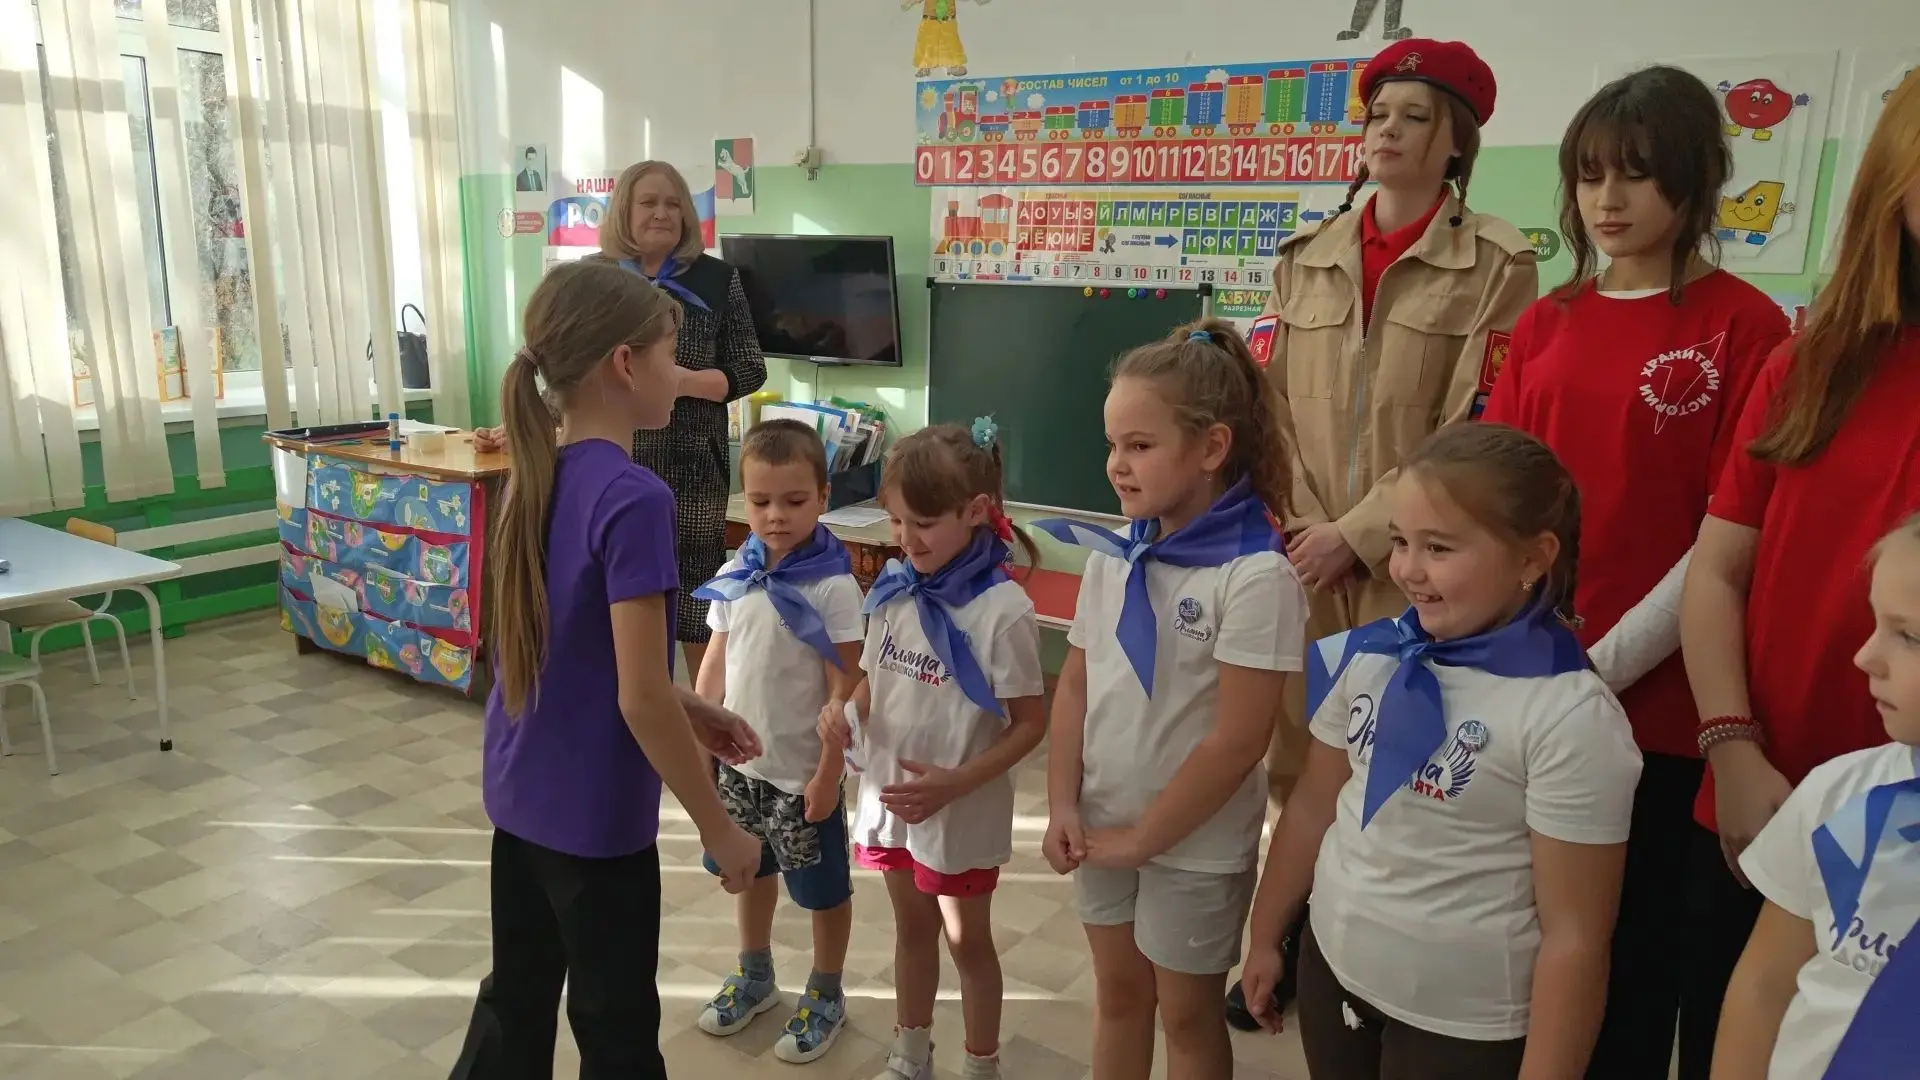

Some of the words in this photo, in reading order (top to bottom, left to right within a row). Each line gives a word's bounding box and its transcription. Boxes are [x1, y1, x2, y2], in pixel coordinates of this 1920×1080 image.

[1284, 70, 1290, 78] 9
[1324, 63, 1334, 71] 10
[1018, 80, 1064, 91] СОСТАВ
[1068, 77, 1108, 88] ЧИСЕЛ
[1120, 78, 1133, 86] от
[1136, 75, 1142, 84] 1
[1146, 76, 1161, 86] до
[1165, 73, 1179, 83] 10
[918, 151, 934, 179] 0
[941, 151, 951, 179] 1
[958, 151, 973, 179] 2
[978, 150, 994, 179] 3
[998, 149, 1016, 179] 4
[1020, 149, 1038, 178] 5
[1042, 148, 1060, 178] 6
[1065, 148, 1082, 178] 7
[1086, 147, 1106, 178] 8
[1110, 147, 1129, 178] 9
[1133, 146, 1154, 178] 10
[1158, 146, 1178, 177] 11
[1183, 146, 1205, 176] 12
[1207, 144, 1231, 176] 13
[1233, 144, 1258, 176] 14
[1260, 144, 1286, 176] 15
[1288, 143, 1312, 176] 16
[1316, 144, 1342, 176] 17
[577, 178, 615, 194] НАША
[568, 202, 604, 229] РО
[1019, 207, 1030, 220] А
[1034, 207, 1046, 220] О
[1052, 208, 1062, 220] У
[1065, 207, 1080, 220] Ы
[1083, 208, 1094, 220] Э
[1100, 204, 1110, 220] Й
[1116, 208, 1127, 220] Л
[1132, 208, 1146, 220] М
[1151, 208, 1162, 220] Н
[1169, 208, 1180, 220] Р
[1187, 208, 1199, 221] Б
[1206, 208, 1216, 222] В
[1225, 208, 1235, 222] Г
[1242, 209, 1256, 224] Д
[1259, 209, 1276, 222] Ж
[1282, 209, 1293, 222] З
[1018, 232, 1028, 244] Я
[1034, 230, 1044, 244] Ё
[1048, 232, 1062, 245] Ю
[1066, 233, 1076, 245] И
[1082, 233, 1091, 245] Е
[1186, 235, 1197, 248] П
[1202, 234, 1216, 248] Ф
[1222, 236, 1233, 248] К
[1242, 236, 1254, 249] Т
[1257, 236, 1274, 250] Ш
[939, 262, 946, 272] 0
[958, 263, 963, 272] 1
[976, 263, 982, 272] 2
[994, 264, 1000, 273] 3
[1014, 264, 1020, 274] 4
[1034, 265, 1040, 274] 5
[1053, 266, 1060, 276] 6
[1074, 266, 1080, 276] 7
[1094, 266, 1100, 277] 8
[1114, 267, 1122, 278] 9
[1134, 268, 1146, 279] 10
[1156, 268, 1168, 280] 11
[1178, 269, 1192, 280] 12
[1201, 270, 1214, 281] 13
[1224, 271, 1237, 282] 14
[1248, 272, 1262, 283] 15
[1216, 290, 1268, 304] АЗБУКА
[1640, 350, 1720, 390] ХРАНИТЕЛИ
[1639, 384, 1712, 416] ИСТОРИИ
[880, 660, 940, 687] ДОШКОЛЯТА
